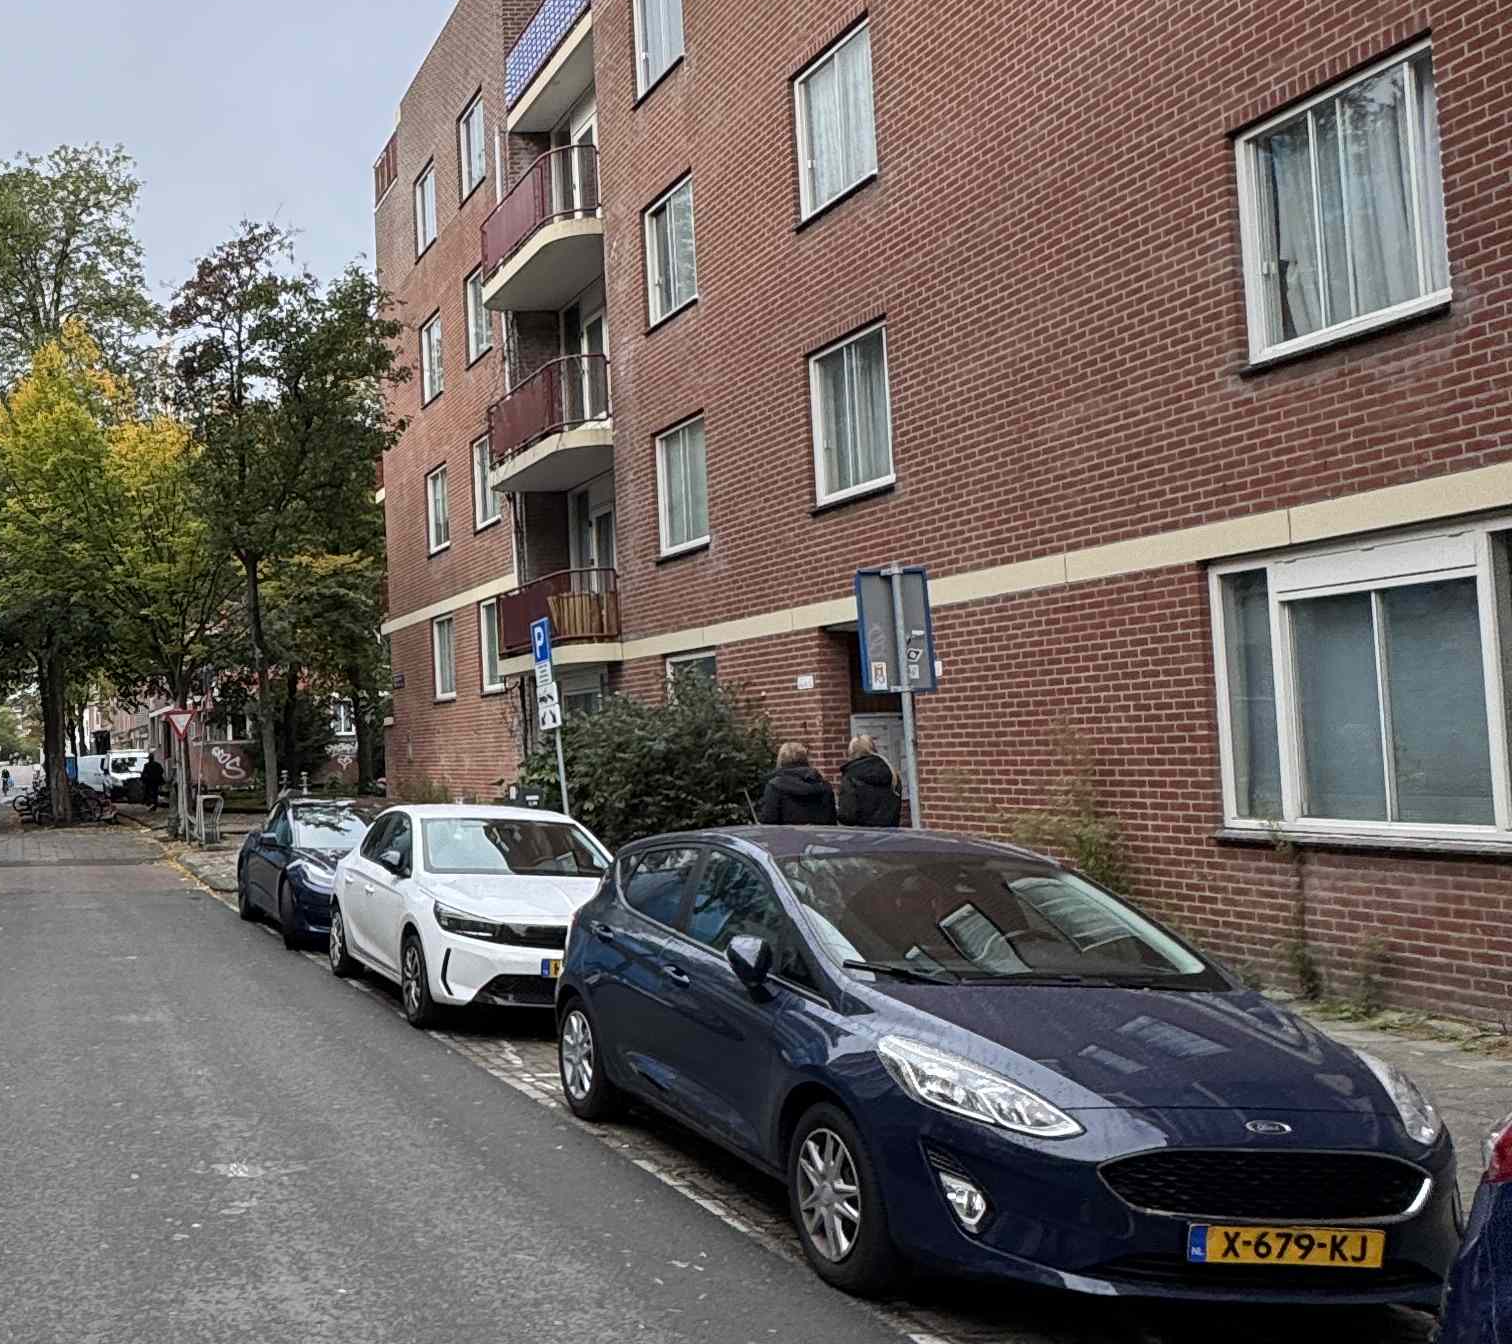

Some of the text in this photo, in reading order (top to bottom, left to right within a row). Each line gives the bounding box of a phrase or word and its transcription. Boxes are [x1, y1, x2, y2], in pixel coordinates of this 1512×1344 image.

[534, 626, 544, 658] P
[1191, 1246, 1204, 1256] NL
[1221, 1231, 1368, 1262] X-679-KJ
